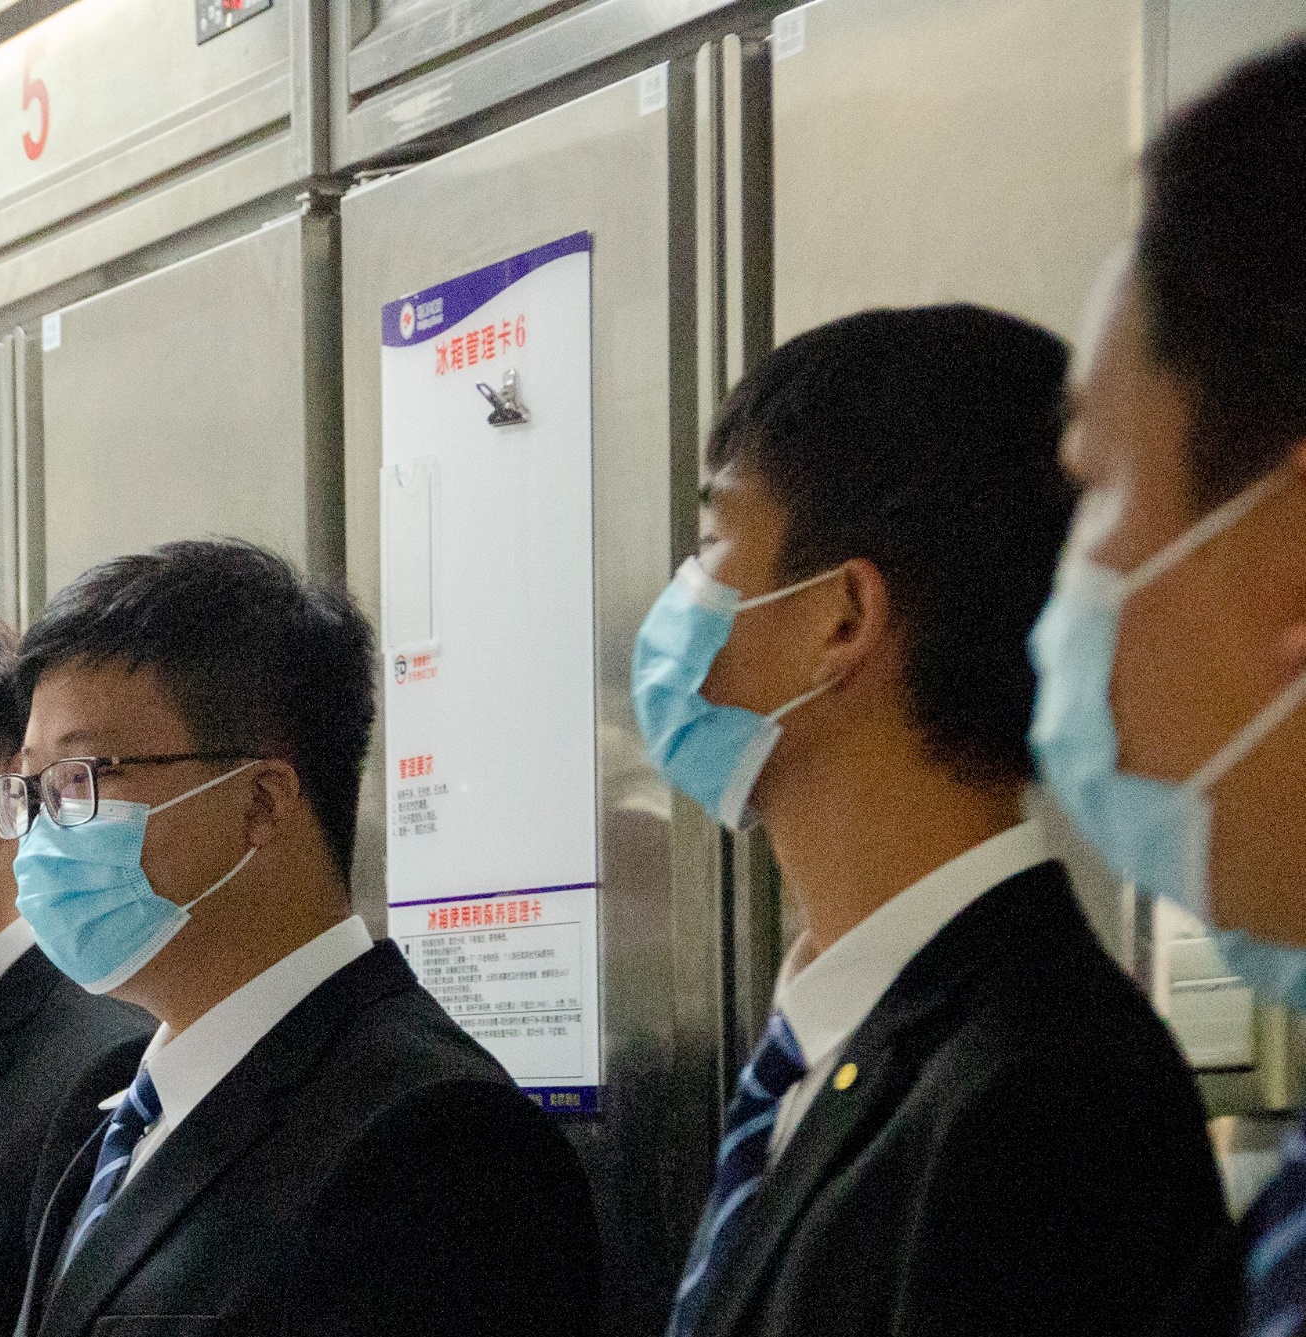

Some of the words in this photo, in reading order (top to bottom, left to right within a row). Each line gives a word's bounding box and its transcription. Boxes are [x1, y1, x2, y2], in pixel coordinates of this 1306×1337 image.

[22, 38, 49, 161] 5
[435, 314, 526, 375] 冰箱管理卡6
[427, 900, 542, 930] 冰箱使用和保养管理卡
